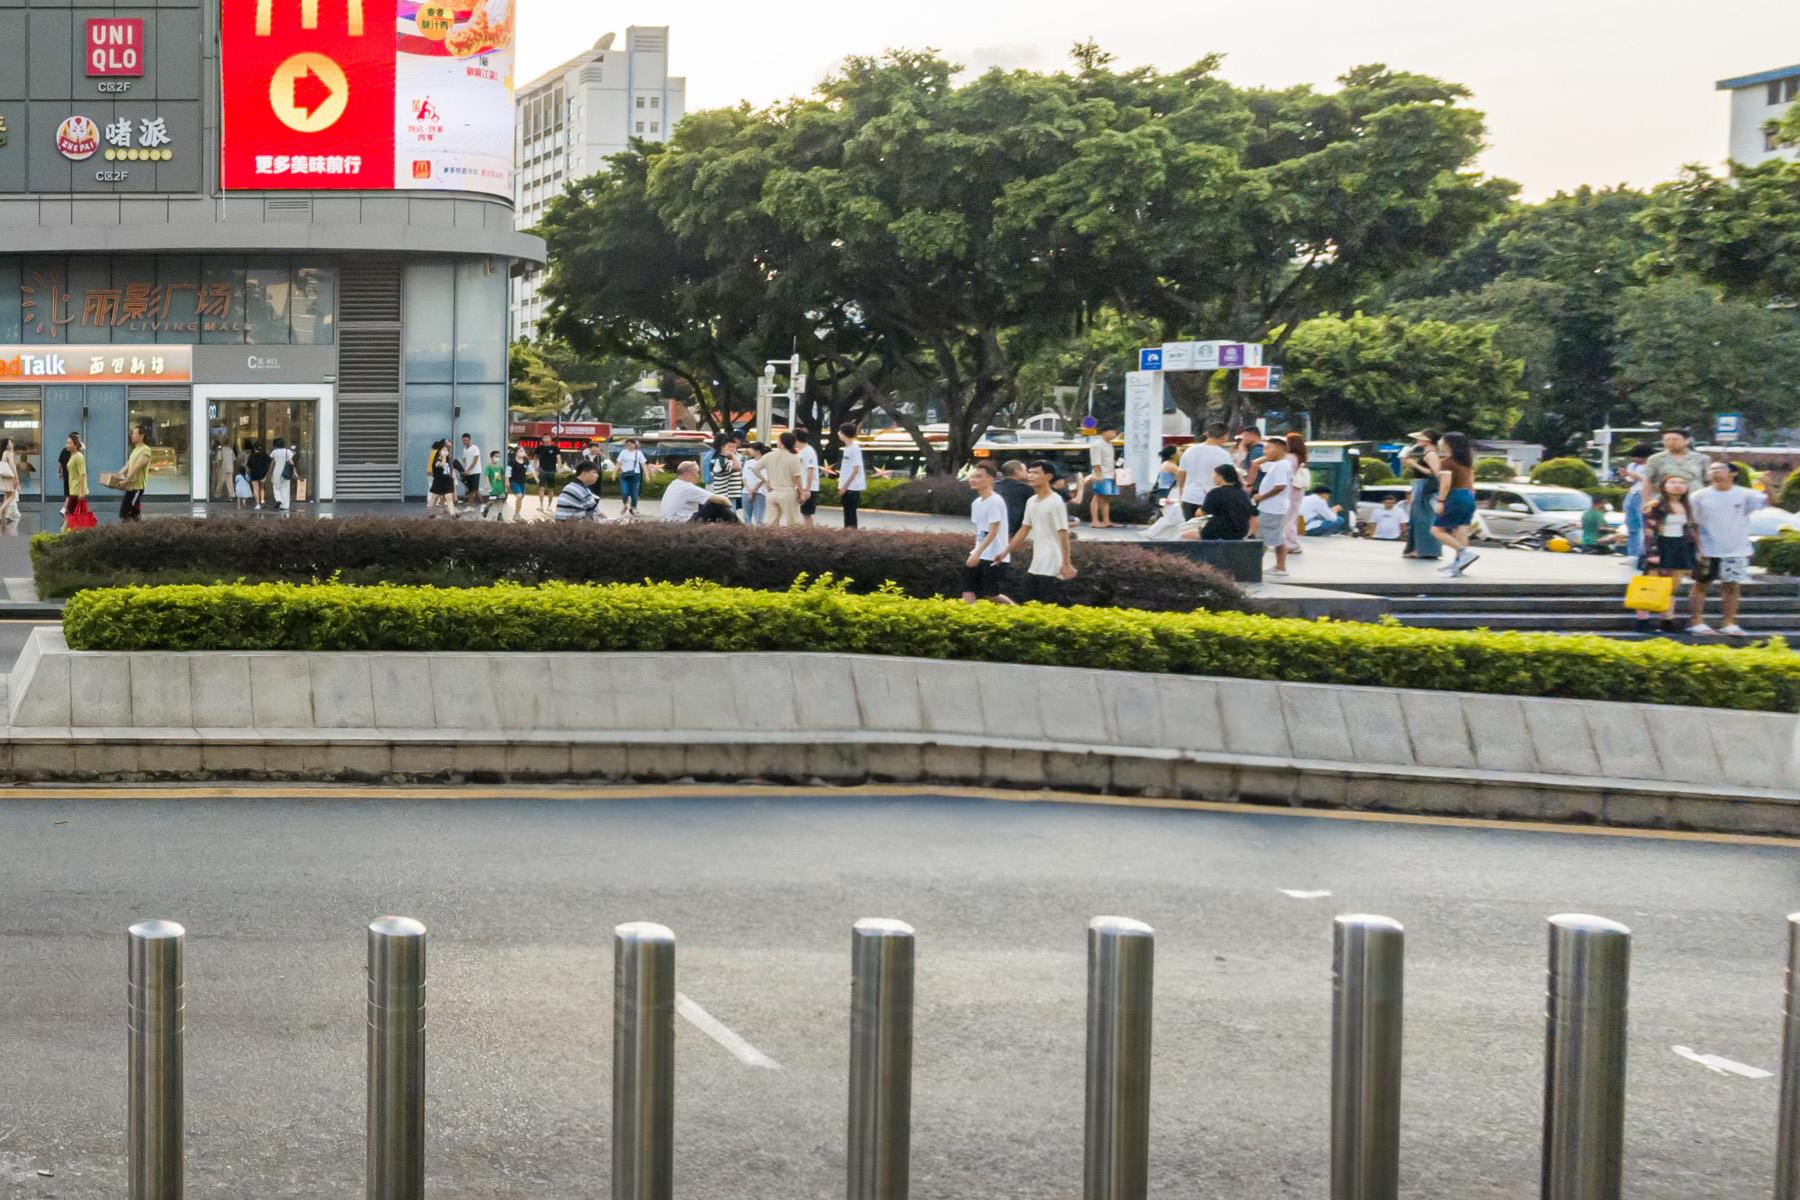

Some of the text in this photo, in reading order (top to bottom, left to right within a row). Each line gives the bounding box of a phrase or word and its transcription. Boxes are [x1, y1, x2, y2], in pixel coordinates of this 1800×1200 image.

[92, 25, 133, 45] UNI
[92, 48, 137, 71] QLO
[98, 82, 131, 92] C区2F
[105, 117, 171, 147] 啫派
[96, 171, 129, 181] C区2F
[81, 283, 233, 326] 丽影广场
[129, 321, 199, 333] LIVING
